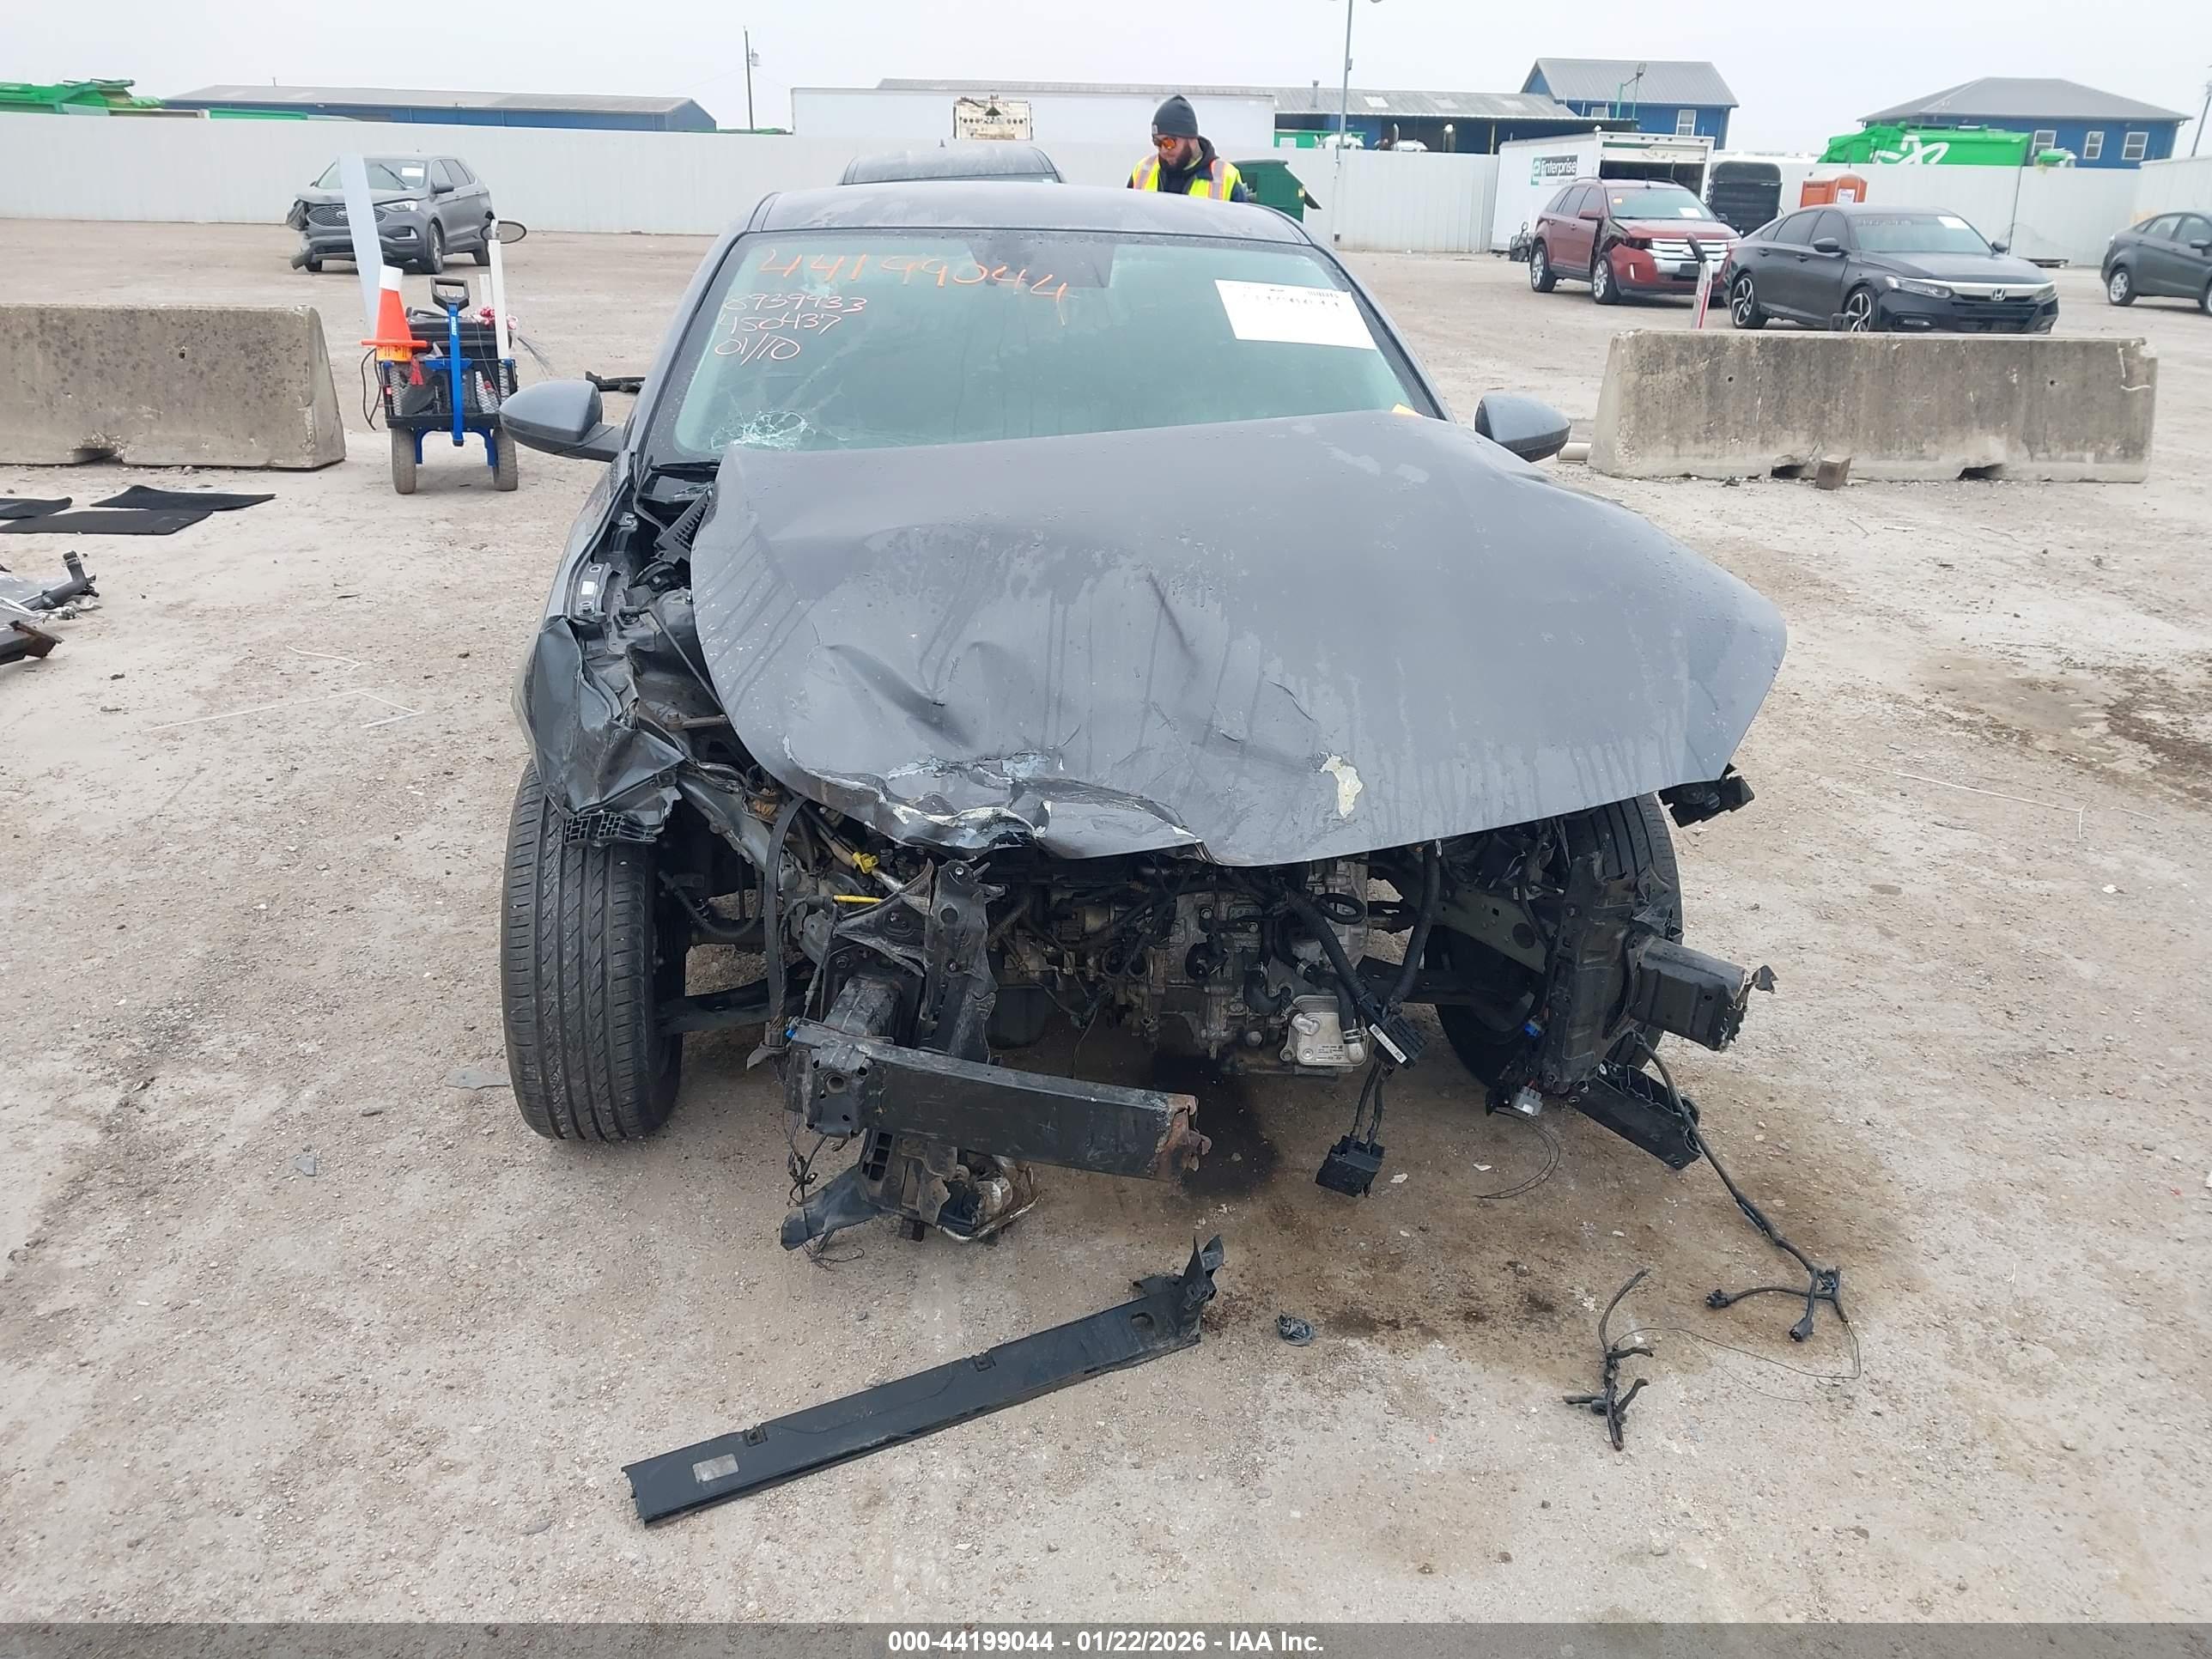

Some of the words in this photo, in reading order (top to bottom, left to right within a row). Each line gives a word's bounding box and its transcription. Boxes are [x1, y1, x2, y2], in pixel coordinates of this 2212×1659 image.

[1541, 157, 1577, 177] Enterprise
[758, 246, 1078, 316] 44199044
[720, 312, 842, 335] 450437
[714, 332, 800, 366] 01/10
